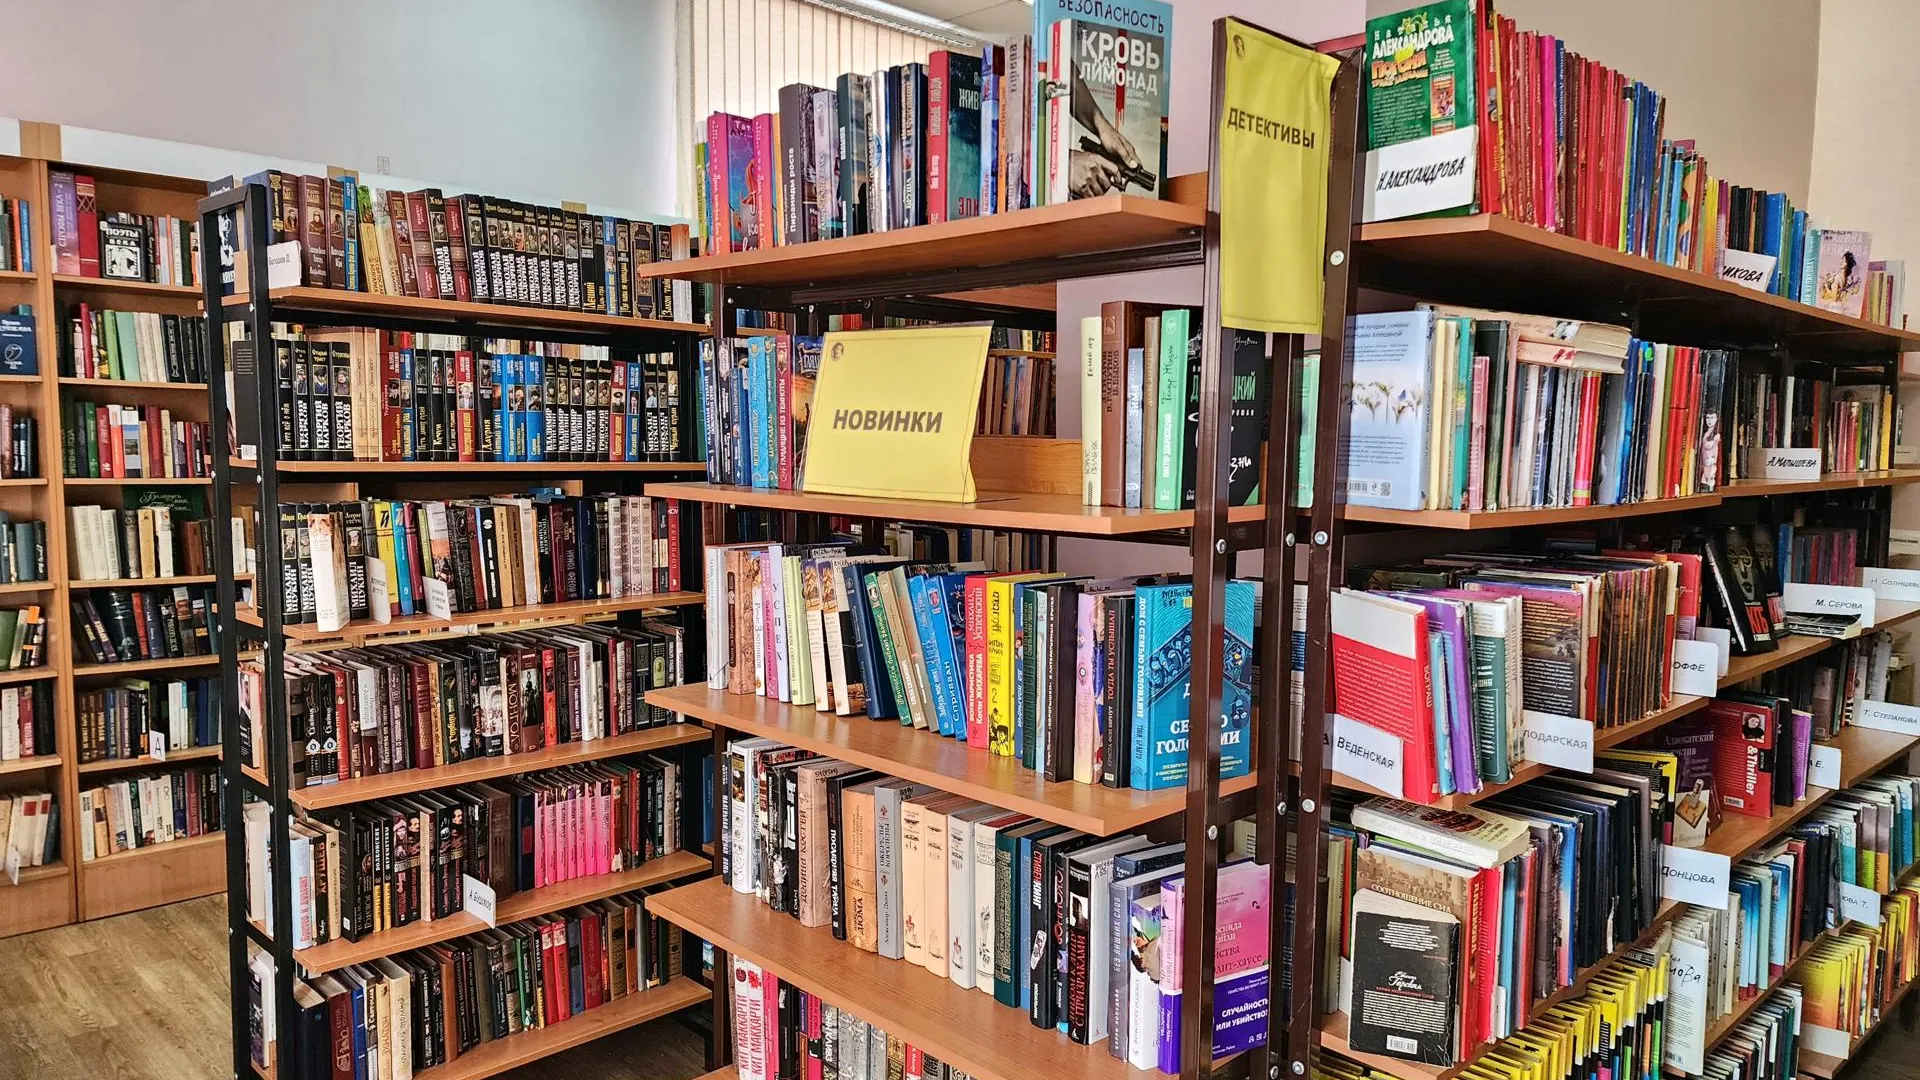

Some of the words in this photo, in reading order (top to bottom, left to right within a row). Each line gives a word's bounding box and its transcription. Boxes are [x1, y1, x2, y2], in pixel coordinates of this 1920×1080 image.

[1081, 29, 1160, 70] КРОВЬ
[1372, 24, 1454, 59] АЛЕКСАНДРОВА
[1080, 60, 1158, 96] ЛИМОНАД
[1227, 107, 1316, 150] ДЕТЕКТИВЫ
[335, 400, 345, 449] ГЕОРГИЙ
[342, 403, 352, 449] МАРКОВ
[482, 419, 492, 451] Даурия
[833, 409, 943, 434] НОВИНКИ
[973, 587, 983, 641] Успенский
[1138, 597, 1146, 620] ДОМ
[1815, 599, 1826, 607] М.
[1828, 600, 1863, 609] СЕРОВА
[772, 583, 783, 661] УСПЕХ
[1137, 627, 1145, 664] СЕМЬЮ
[1108, 658, 1115, 670] ТЫ
[1673, 660, 1706, 672] ОФФЕ
[1136, 665, 1145, 718] ГОЛОВАМИ
[507, 683, 519, 744] МОНГОЛ
[1864, 709, 1871, 717] Т.
[1873, 711, 1919, 725] СТЕПАНОВА
[154, 736, 163, 757] А
[1336, 733, 1395, 770] ВЕДЕНСКАЯ
[1745, 745, 1760, 796] &Thriller
[1662, 866, 1716, 885] ДОНЦОВА
[1032, 881, 1042, 910] КИНГ
[1112, 896, 1121, 918] СЛОВ
[1371, 883, 1432, 910] СООТНОШЕНИЕ
[856, 897, 864, 936] ДЮМА
[1112, 921, 1121, 955] ЛИШНИХ
[1075, 935, 1085, 1016] ПРИЗРАКАМИ
[1113, 956, 1121, 972] БЕЗ
[736, 993, 749, 1049] МАККАРТИ
[1222, 997, 1268, 1017] СЛУЧАЙНОСТЬ
[749, 999, 762, 1053] МАККАРТИ
[1216, 1020, 1231, 1032] ИЛИ
[737, 1051, 749, 1070] КИТ
[750, 1056, 762, 1075] КИТ
